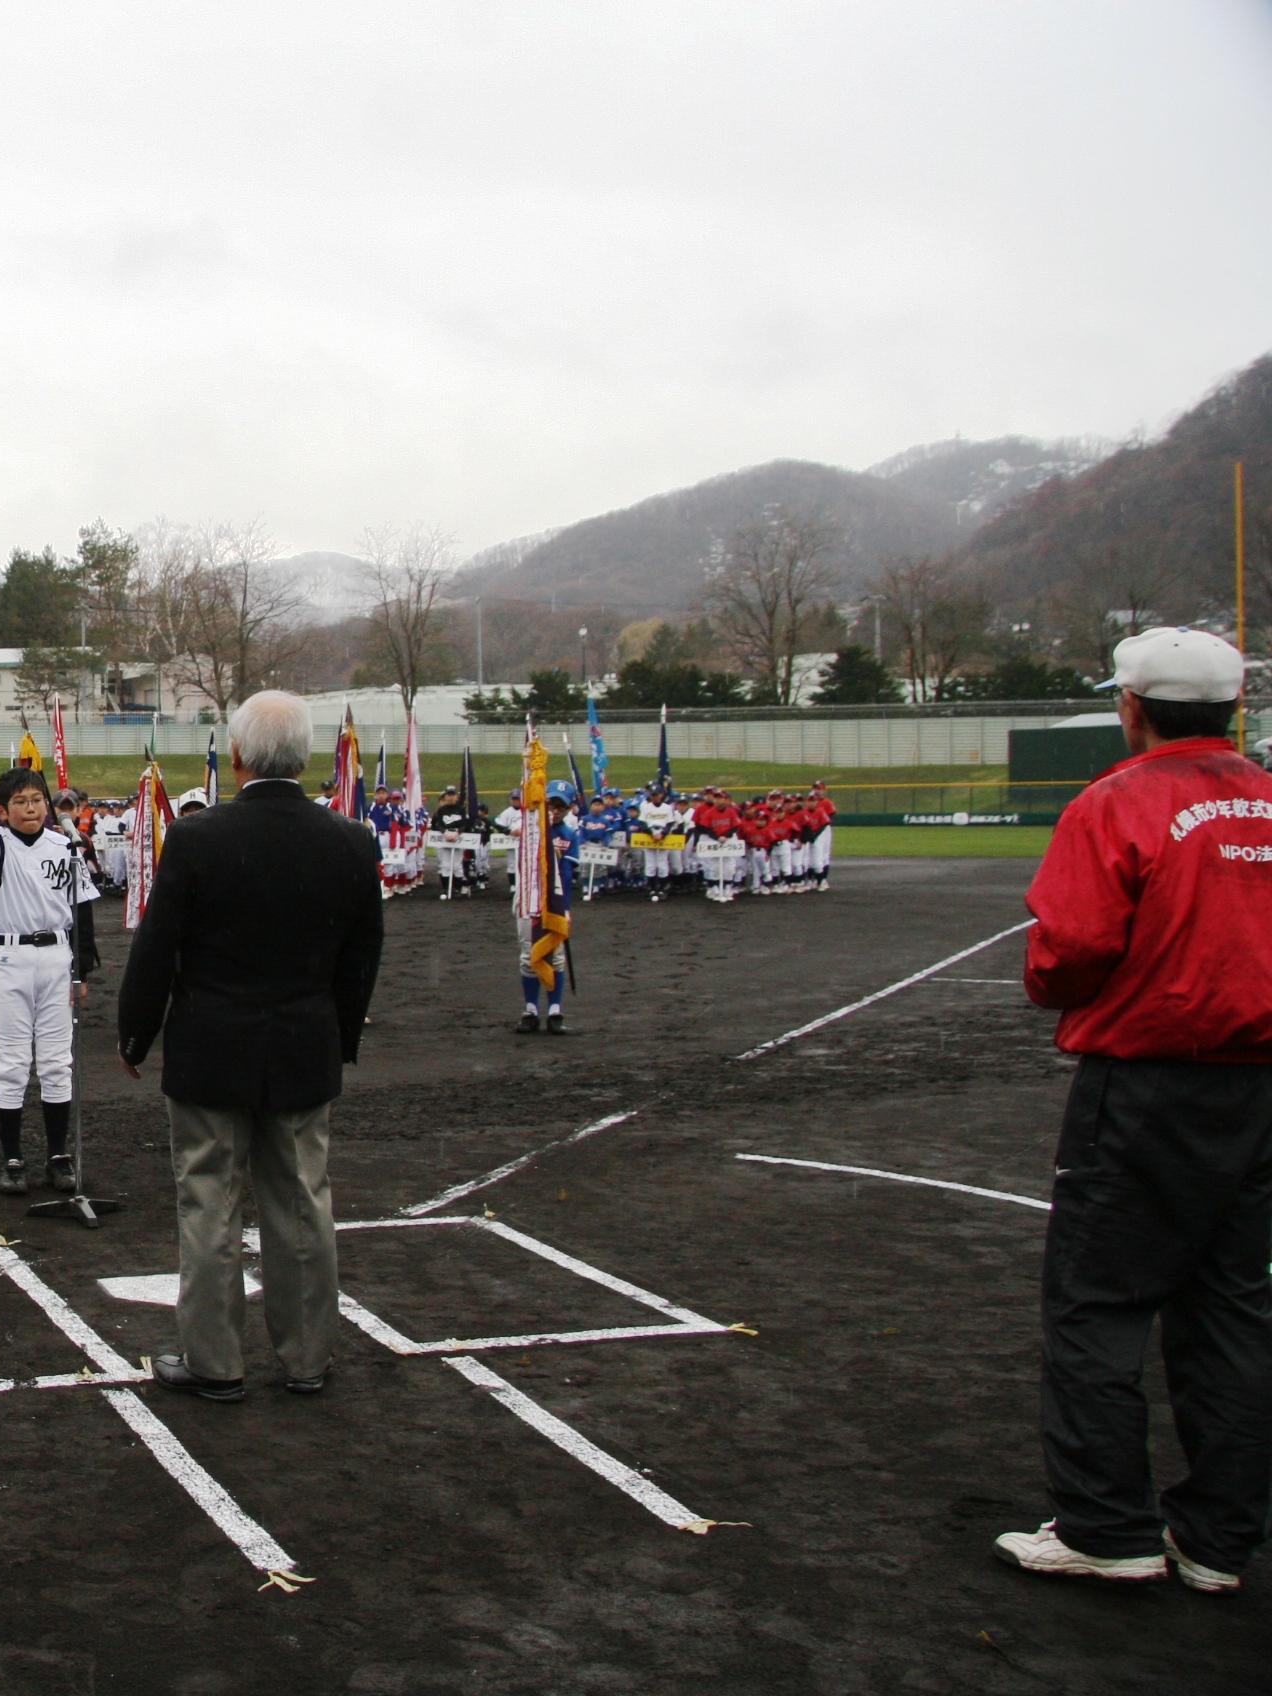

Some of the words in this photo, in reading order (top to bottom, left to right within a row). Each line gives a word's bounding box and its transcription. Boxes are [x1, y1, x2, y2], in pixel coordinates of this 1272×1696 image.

[1170, 798, 1272, 842] 札幌市少年軟式
